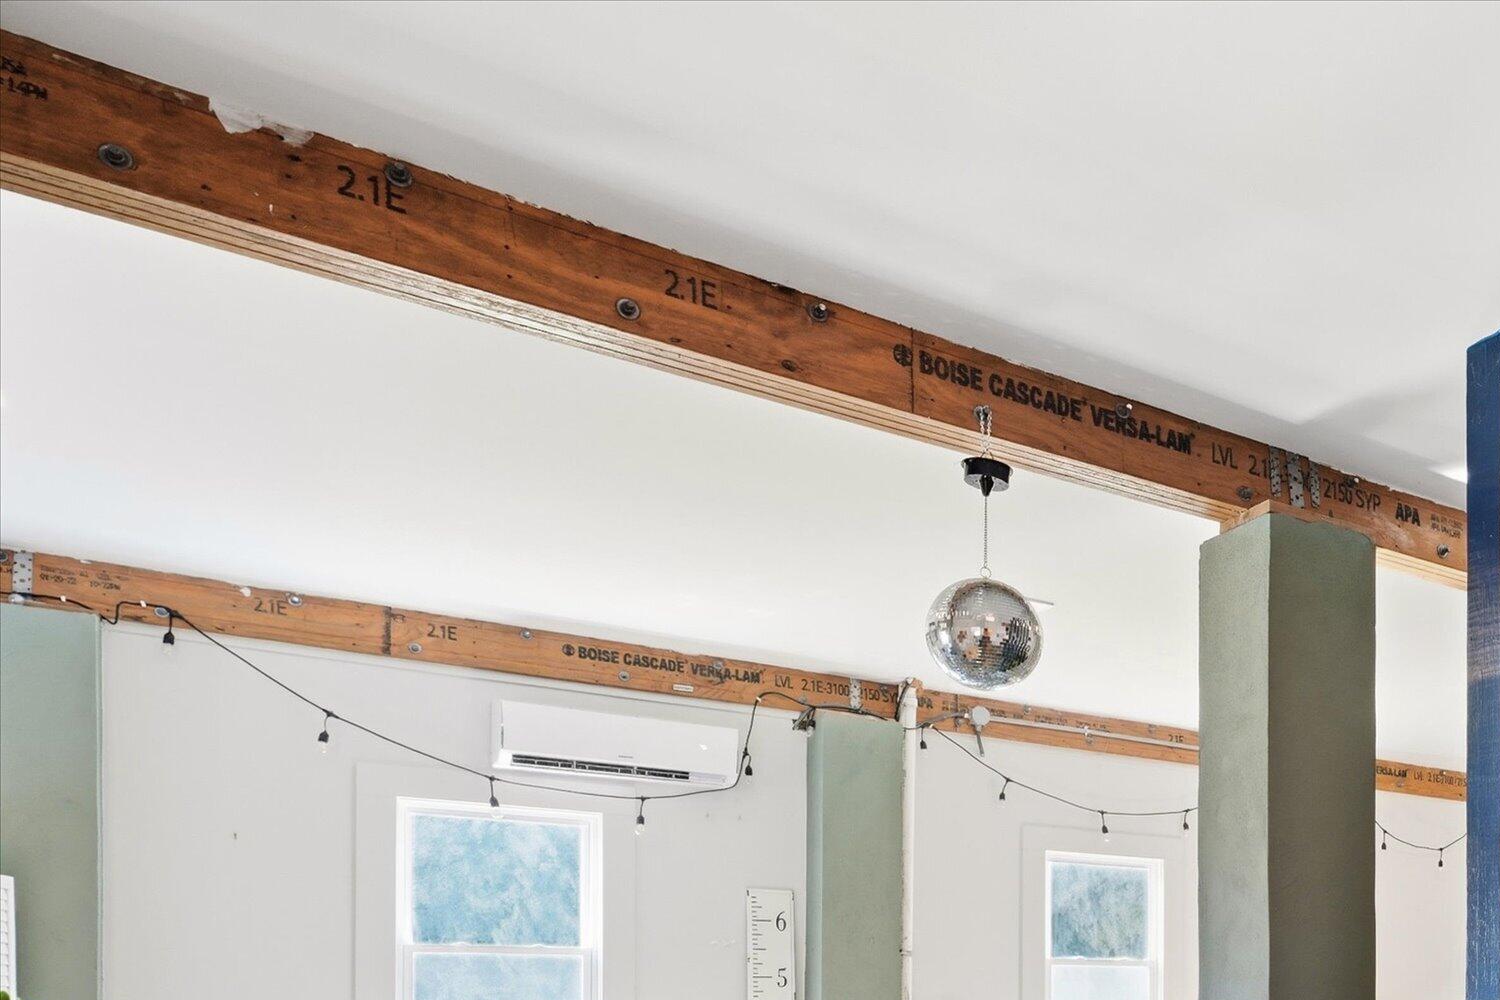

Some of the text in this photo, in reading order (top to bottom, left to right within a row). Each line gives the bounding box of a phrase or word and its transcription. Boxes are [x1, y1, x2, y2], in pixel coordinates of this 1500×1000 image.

[337, 165, 407, 214] 2.1E
[664, 269, 718, 311] 2.1E
[919, 350, 984, 392] BOISE
[988, 373, 1084, 422] CASCADE
[1211, 442, 1238, 470] LVL
[1395, 502, 1421, 527] APA
[254, 598, 288, 617] 2.1E
[427, 623, 458, 641] 2.1E
[578, 646, 620, 664] BOISE
[623, 653, 685, 673] CASCADE
[774, 674, 794, 689] LVL
[776, 911, 787, 932] 6
[777, 967, 788, 988] 5
